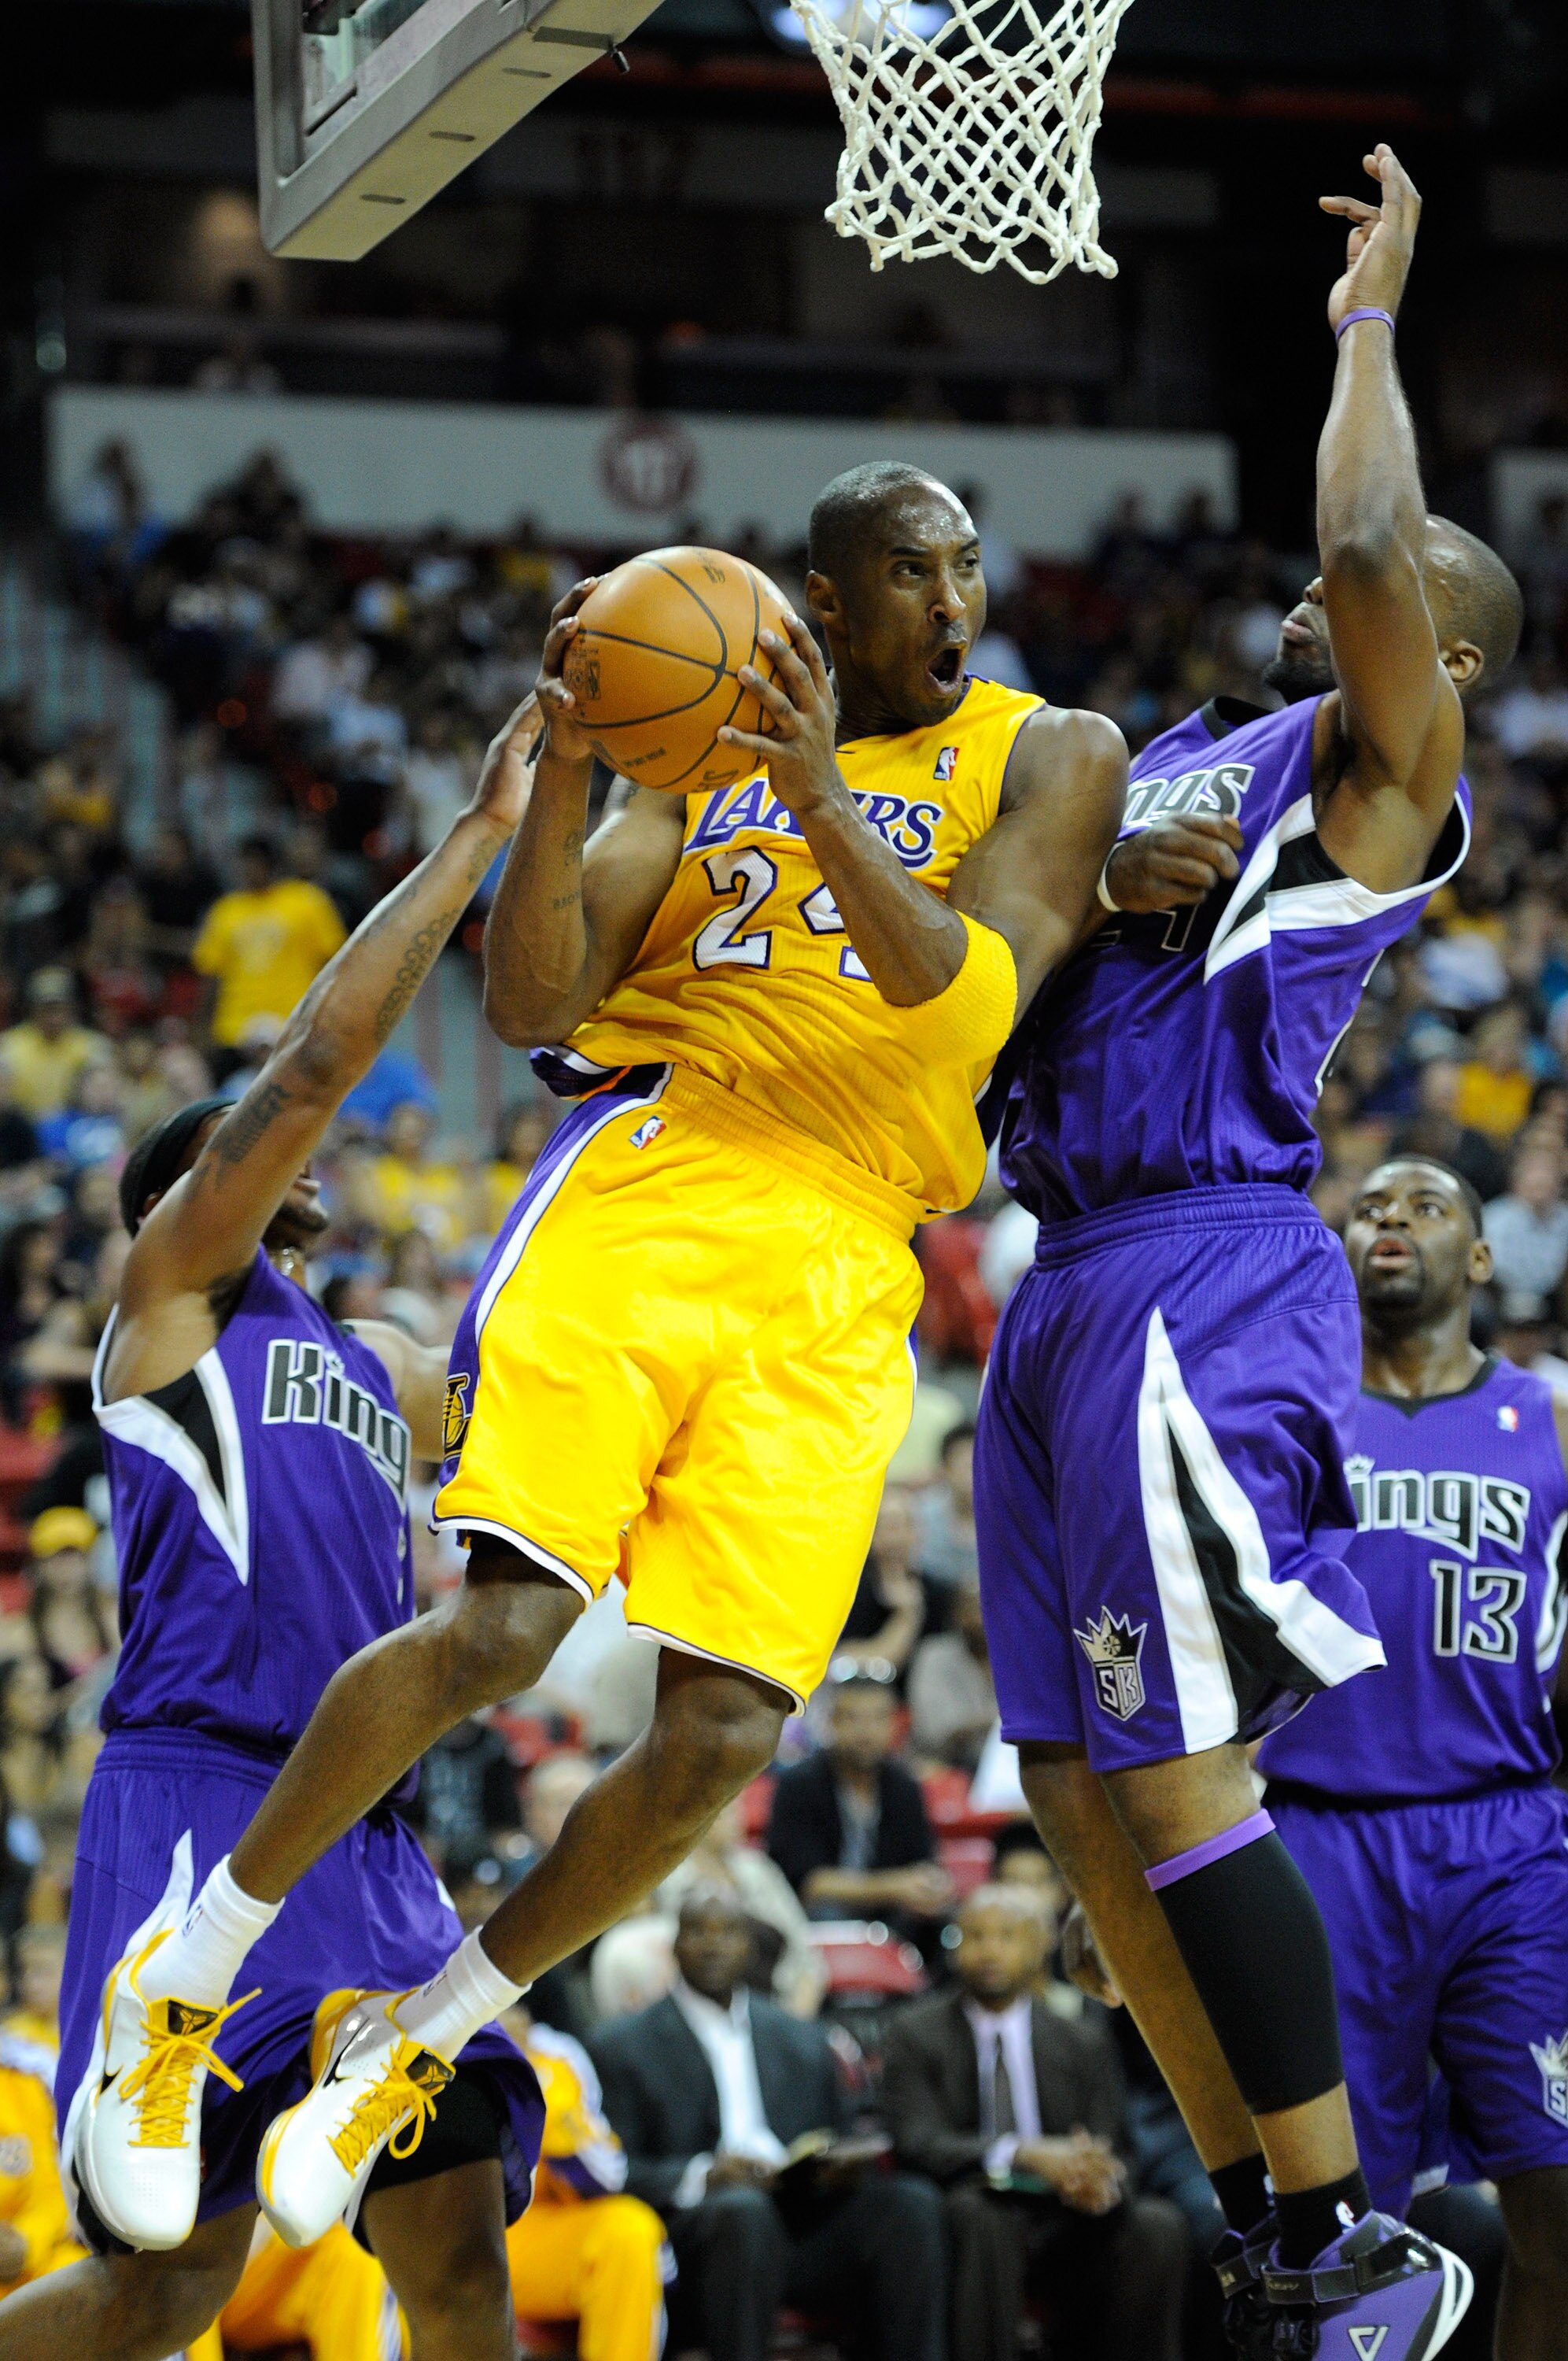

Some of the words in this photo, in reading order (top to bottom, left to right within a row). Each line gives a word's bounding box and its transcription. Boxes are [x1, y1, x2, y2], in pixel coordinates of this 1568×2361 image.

[683, 778, 944, 871] LARS
[1123, 763, 1256, 828] ngs
[1344, 1454, 1531, 1563] ings
[1429, 1558, 1527, 1664] 13
[1098, 1666, 1137, 1709] SK
